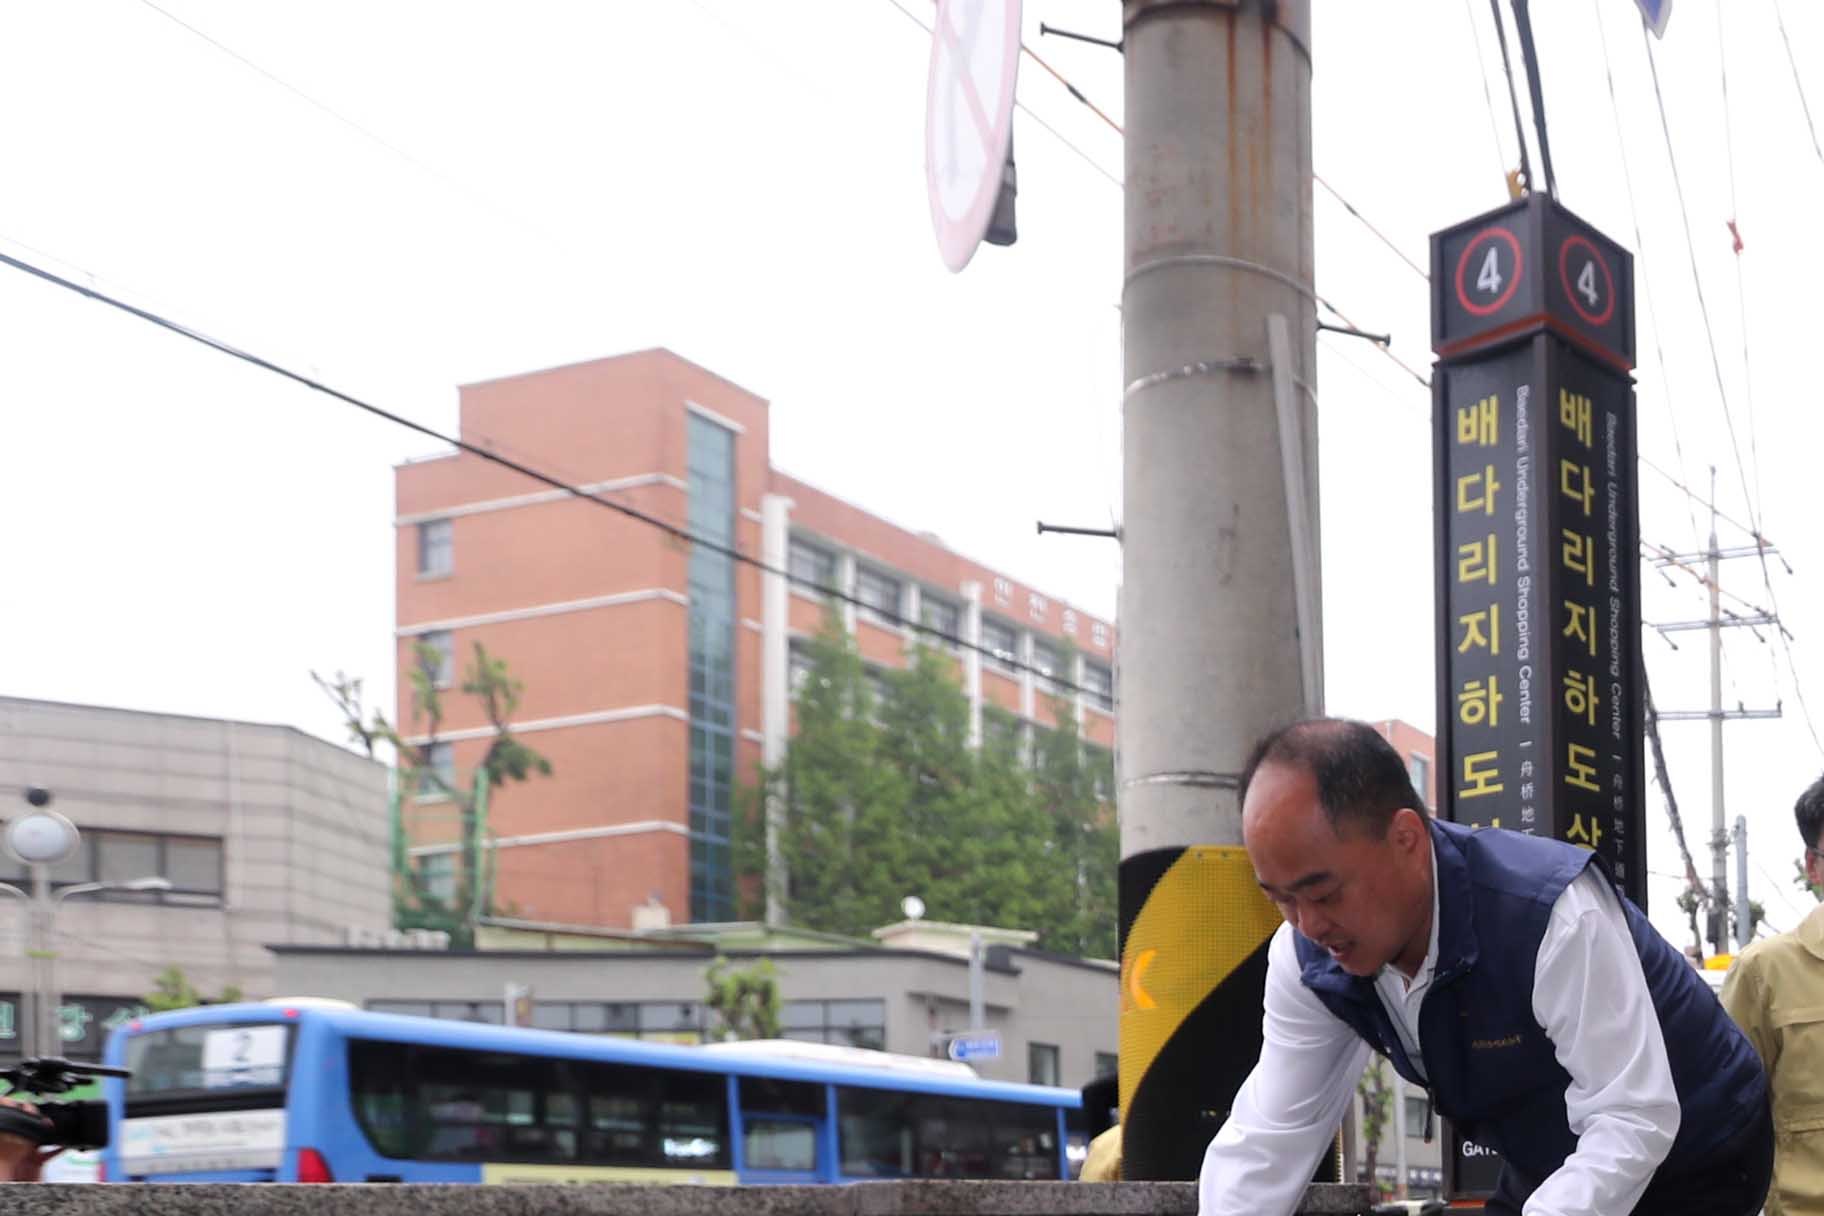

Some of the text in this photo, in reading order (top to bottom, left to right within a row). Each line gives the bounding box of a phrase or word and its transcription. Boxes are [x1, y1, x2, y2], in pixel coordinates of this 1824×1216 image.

[1476, 246, 1502, 294] 4
[1577, 259, 1598, 305] 4
[1514, 456, 1529, 571] Underground
[1607, 482, 1620, 593] Underground
[1457, 395, 1504, 828] 배다리지하도
[1516, 575, 1531, 660] Shopping
[1609, 597, 1622, 678] Shopping
[1519, 665, 1533, 724] Center
[1611, 682, 1623, 739] Center
